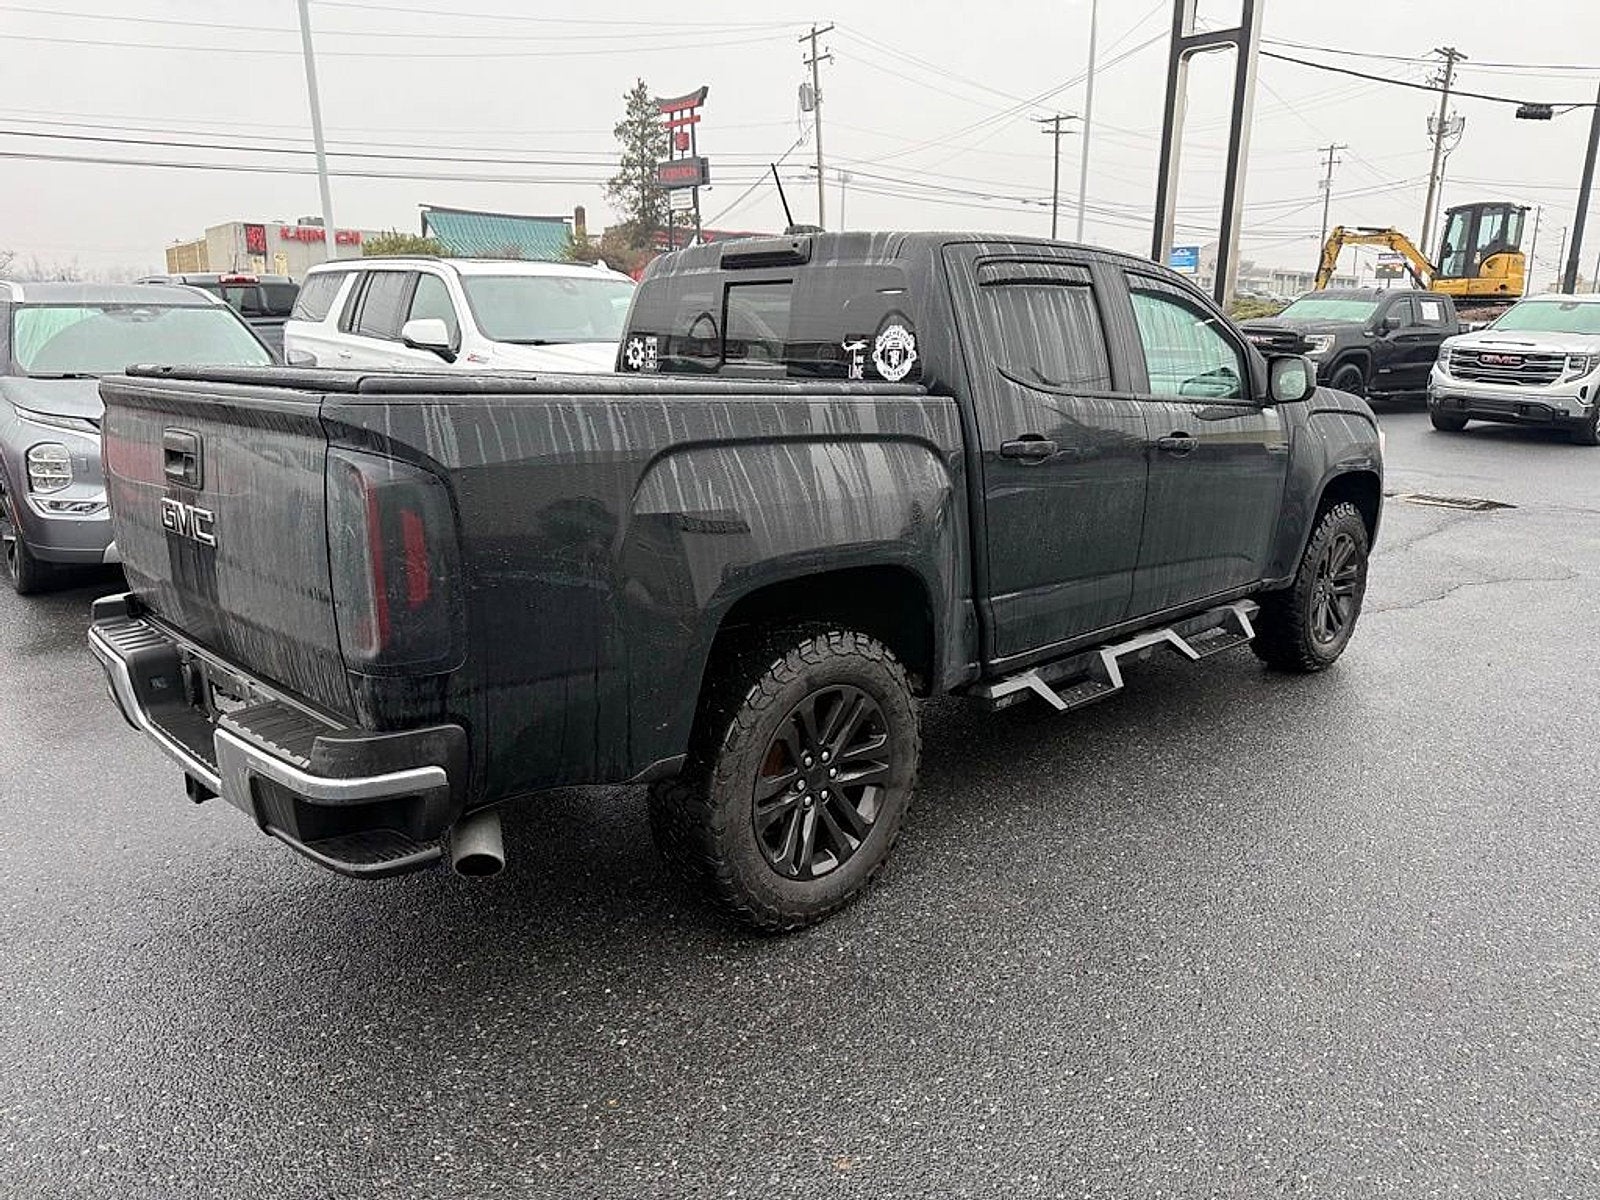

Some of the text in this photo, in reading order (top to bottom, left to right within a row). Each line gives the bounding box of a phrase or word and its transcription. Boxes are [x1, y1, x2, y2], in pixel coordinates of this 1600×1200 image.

[280, 226, 361, 245] KAJIMCHI
[1480, 354, 1522, 364] GMC
[161, 497, 217, 548] GMC
